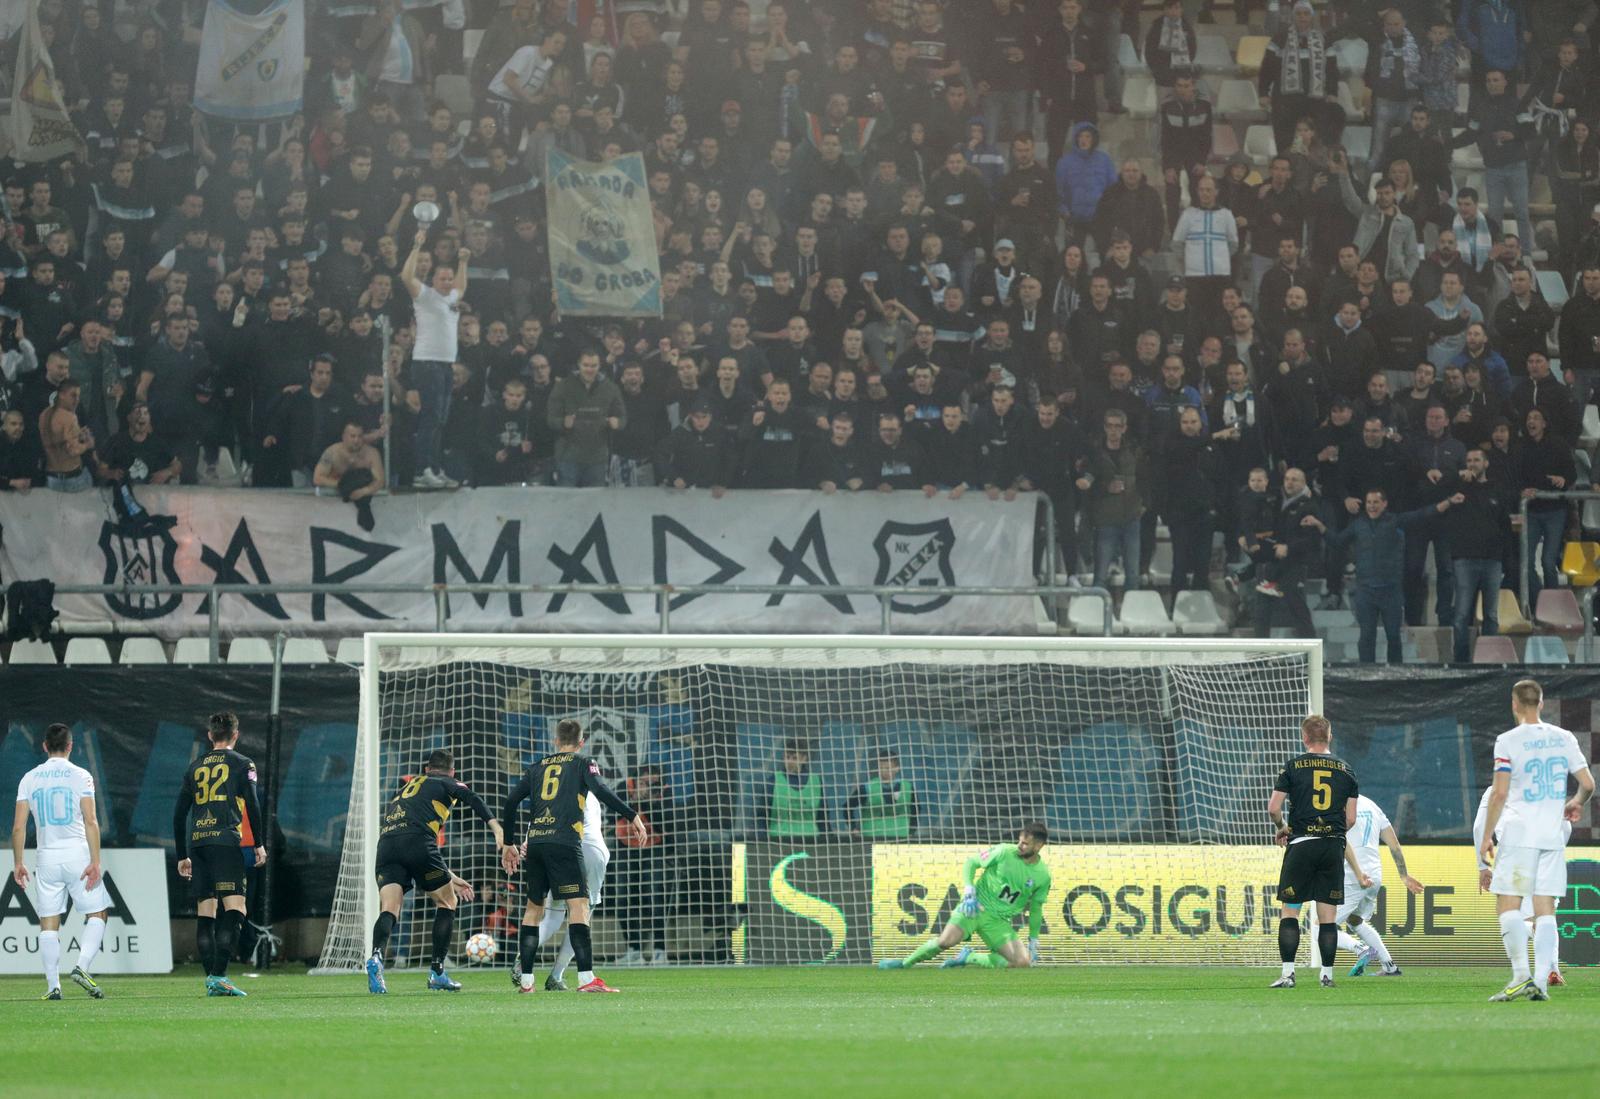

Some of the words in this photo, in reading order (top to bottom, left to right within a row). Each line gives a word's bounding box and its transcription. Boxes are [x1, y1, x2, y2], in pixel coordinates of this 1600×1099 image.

[595, 267, 656, 291] GROBA
[195, 507, 857, 622] ARMADA
[894, 541, 911, 554] NK
[194, 763, 230, 805] 32
[540, 764, 562, 801] 6
[1294, 758, 1347, 772] KLEINHEISLER
[1523, 756, 1569, 803] 36
[31, 785, 74, 828] 10
[1312, 769, 1333, 811] 5
[998, 884, 1020, 904] M
